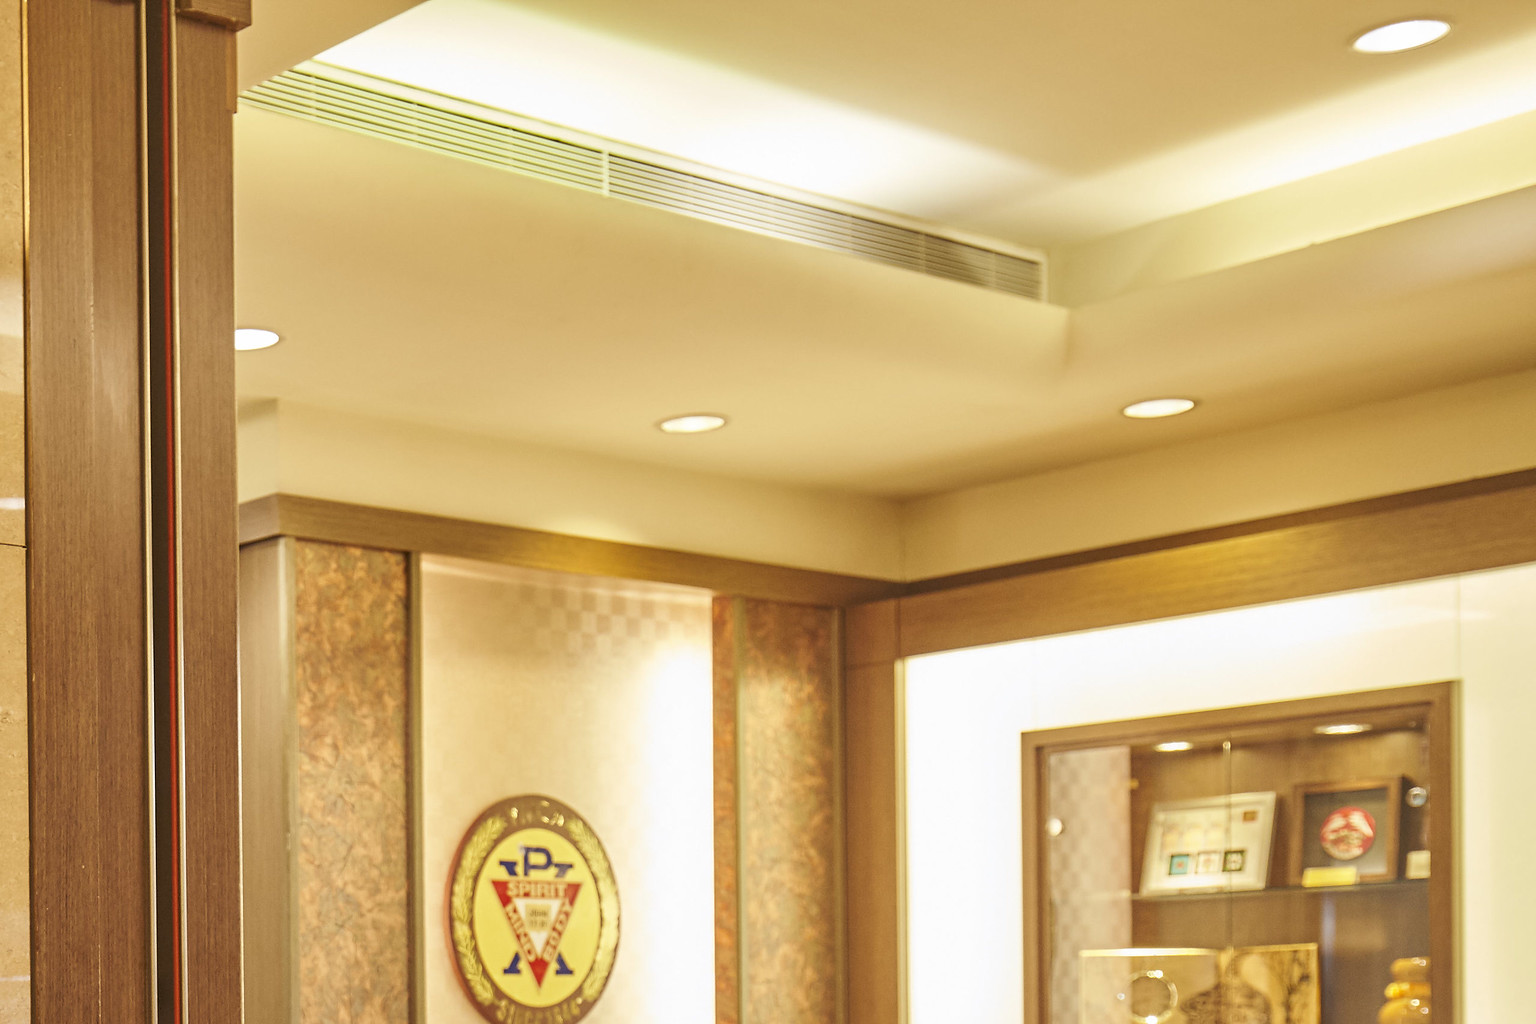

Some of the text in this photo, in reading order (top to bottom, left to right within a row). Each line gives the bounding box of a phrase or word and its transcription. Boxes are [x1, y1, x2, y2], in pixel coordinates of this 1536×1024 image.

[507, 881, 567, 898] SPIRIT
[504, 902, 537, 963] MIND
[542, 898, 573, 963] BODY
